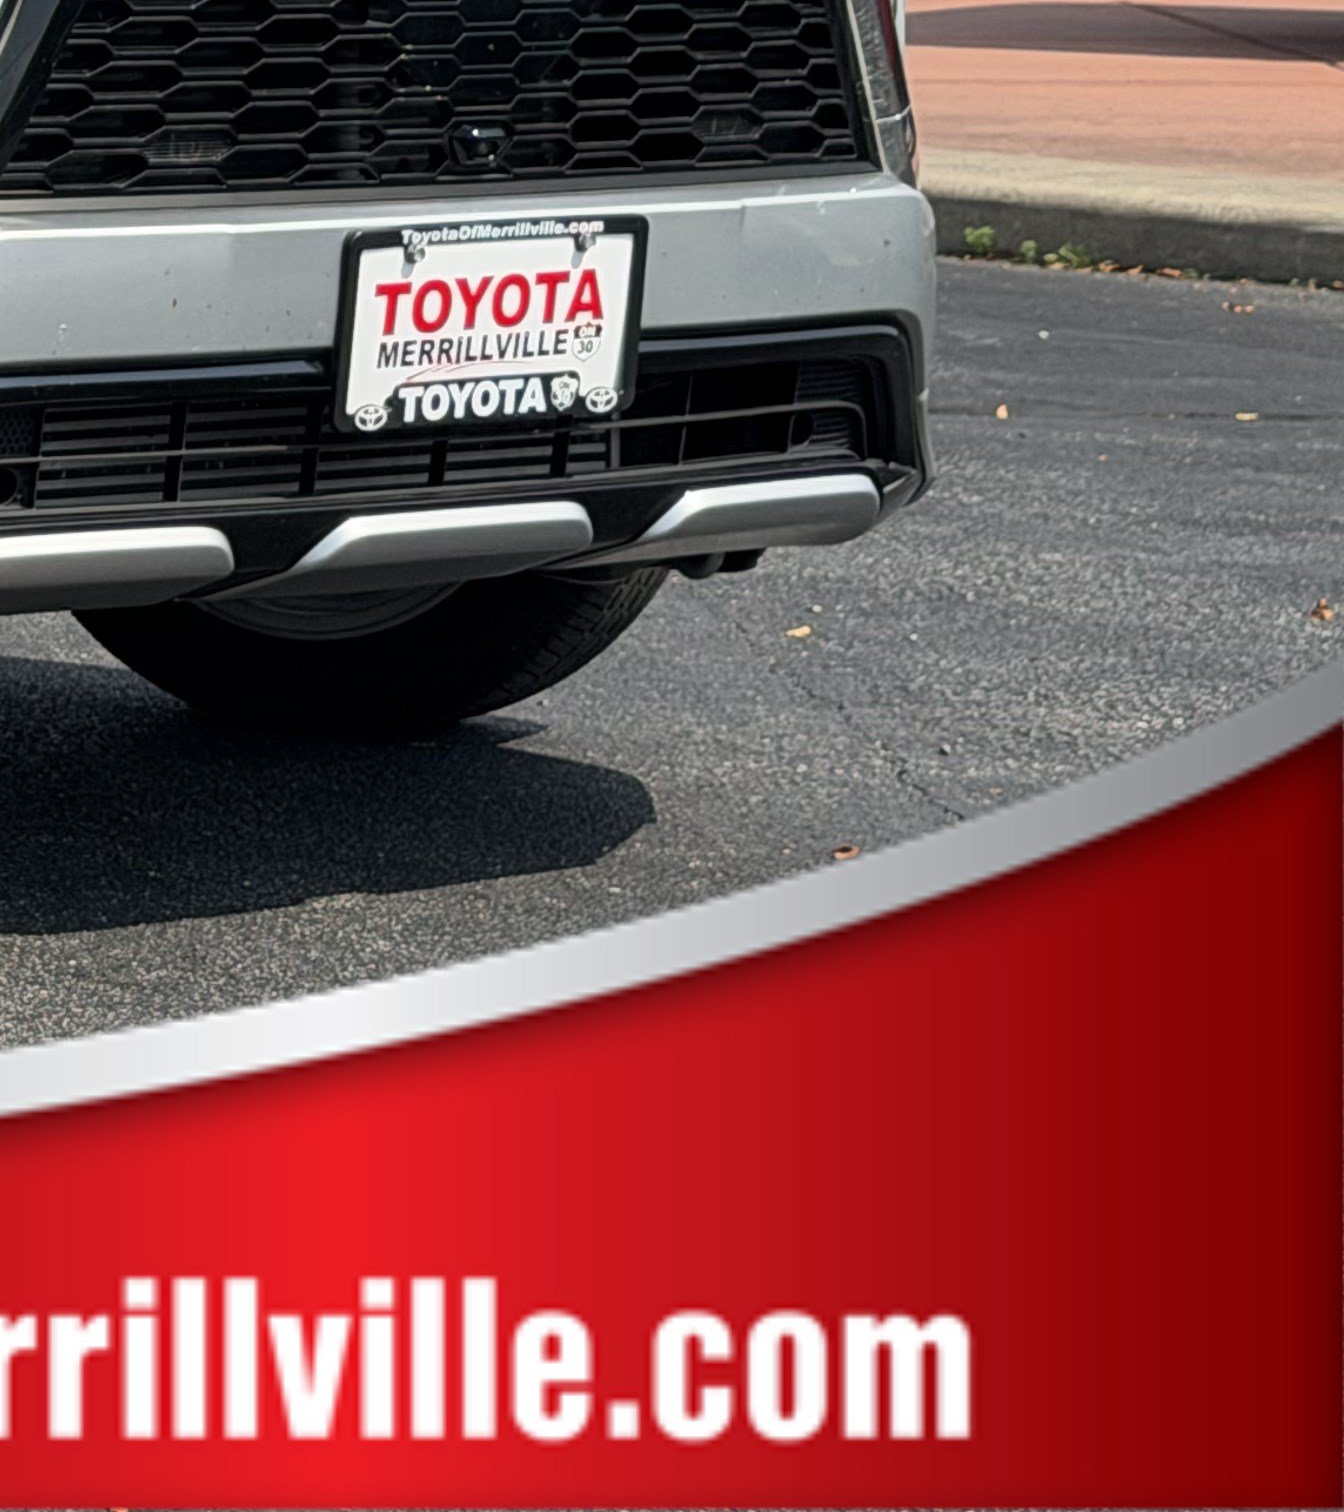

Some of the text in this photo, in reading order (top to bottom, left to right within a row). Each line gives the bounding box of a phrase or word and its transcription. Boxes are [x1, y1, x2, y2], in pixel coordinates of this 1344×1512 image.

[400, 219, 605, 246] ToyotaOfMerrillville.com
[374, 268, 604, 336] TOYOTA
[376, 329, 570, 369] MERRILLVILLE
[398, 376, 547, 423] TOYOTA
